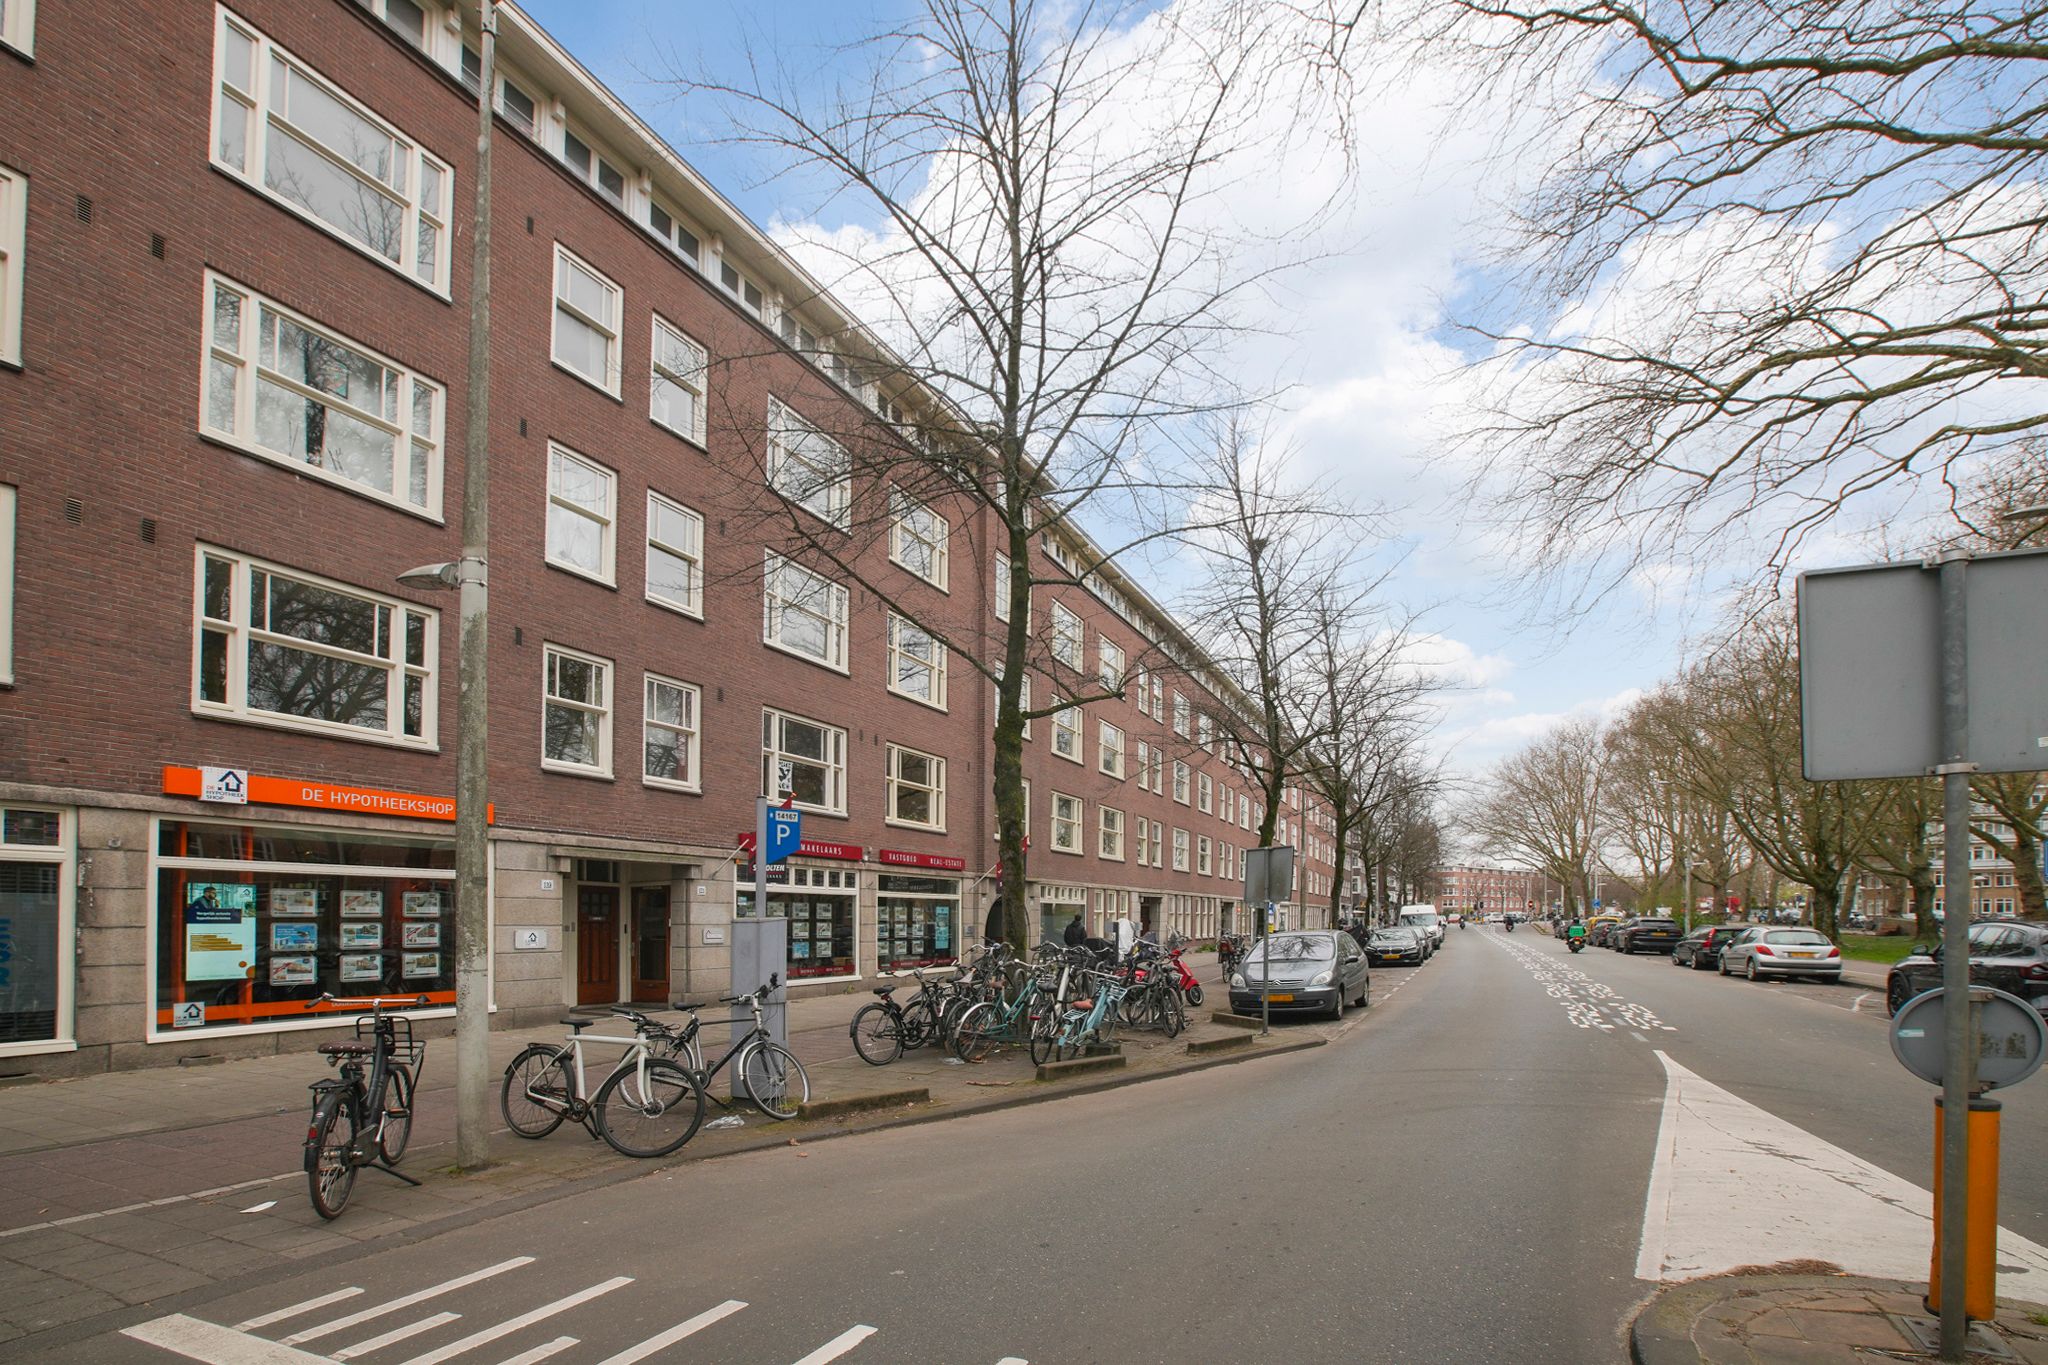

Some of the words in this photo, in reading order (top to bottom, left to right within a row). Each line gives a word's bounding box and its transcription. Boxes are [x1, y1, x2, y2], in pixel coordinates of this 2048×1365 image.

[302, 788, 324, 802] DE
[330, 791, 454, 815] HYPOTHEEKSHOP
[777, 825, 790, 845] P
[752, 864, 785, 872] SOLTEN
